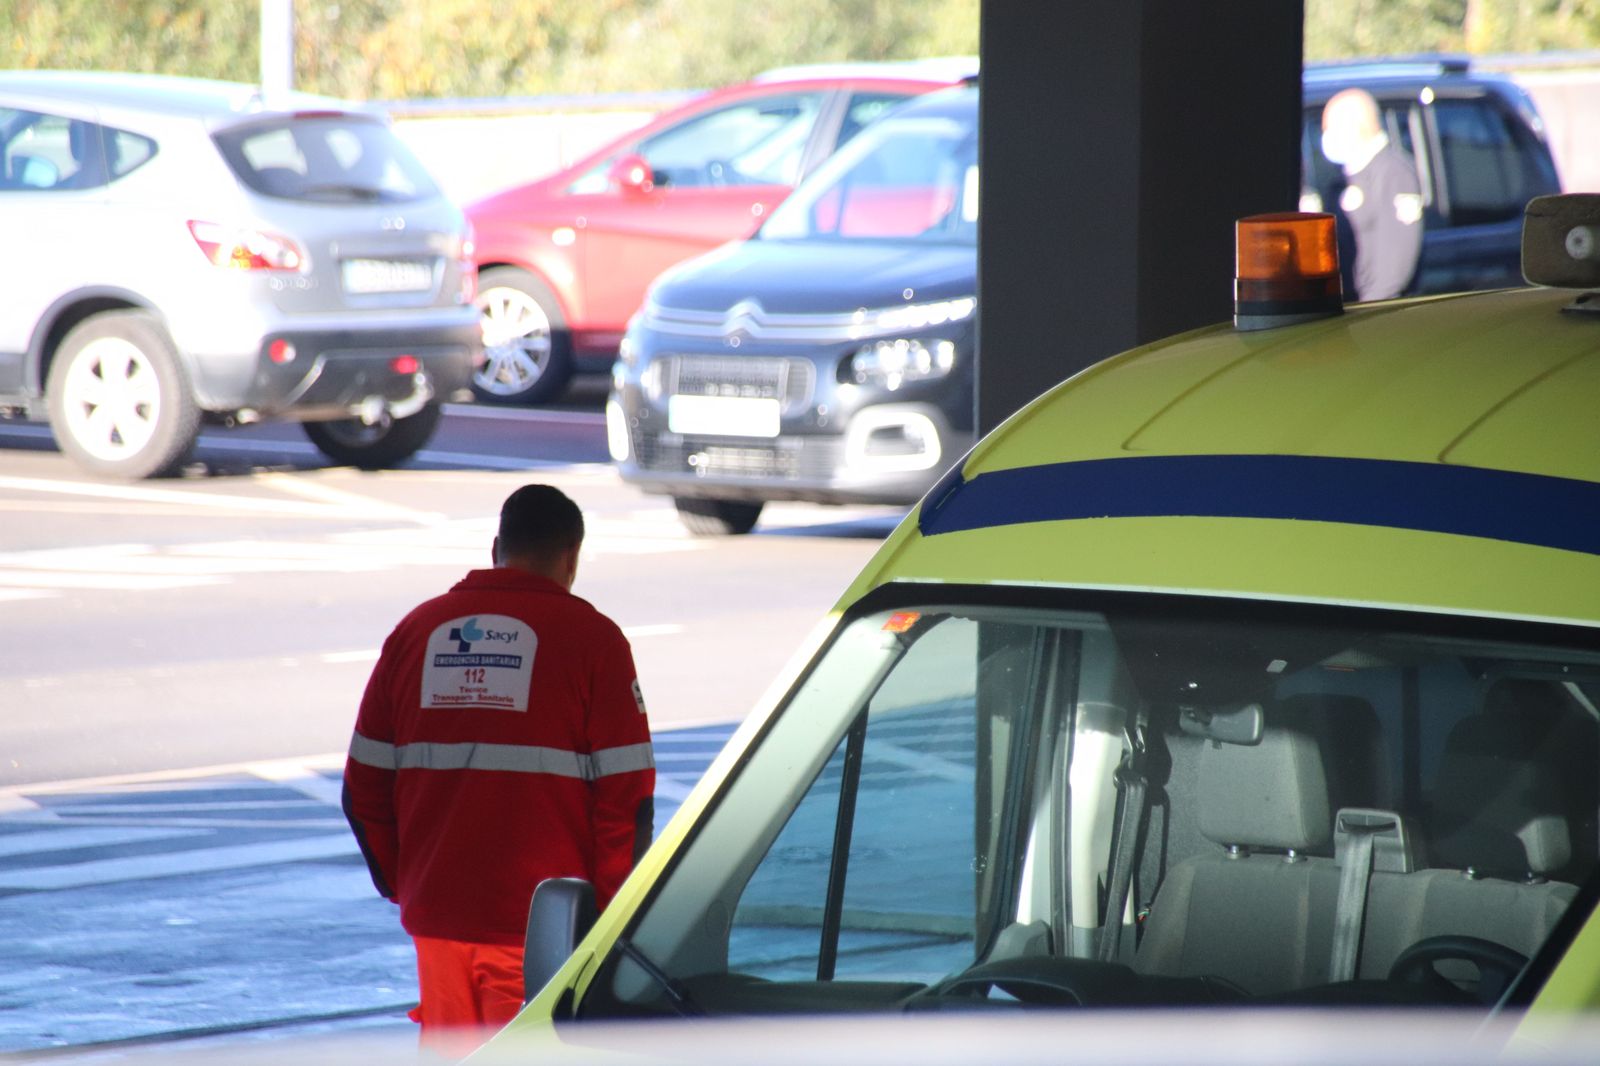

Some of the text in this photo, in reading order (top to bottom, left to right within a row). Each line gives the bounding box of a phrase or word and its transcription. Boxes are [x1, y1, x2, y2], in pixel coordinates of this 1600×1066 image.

[485, 630, 518, 643] Sacyl
[435, 655, 520, 667] EMERGENCIAS SANITARIAS
[464, 669, 485, 683] 112
[478, 694, 513, 703] Sanitario
